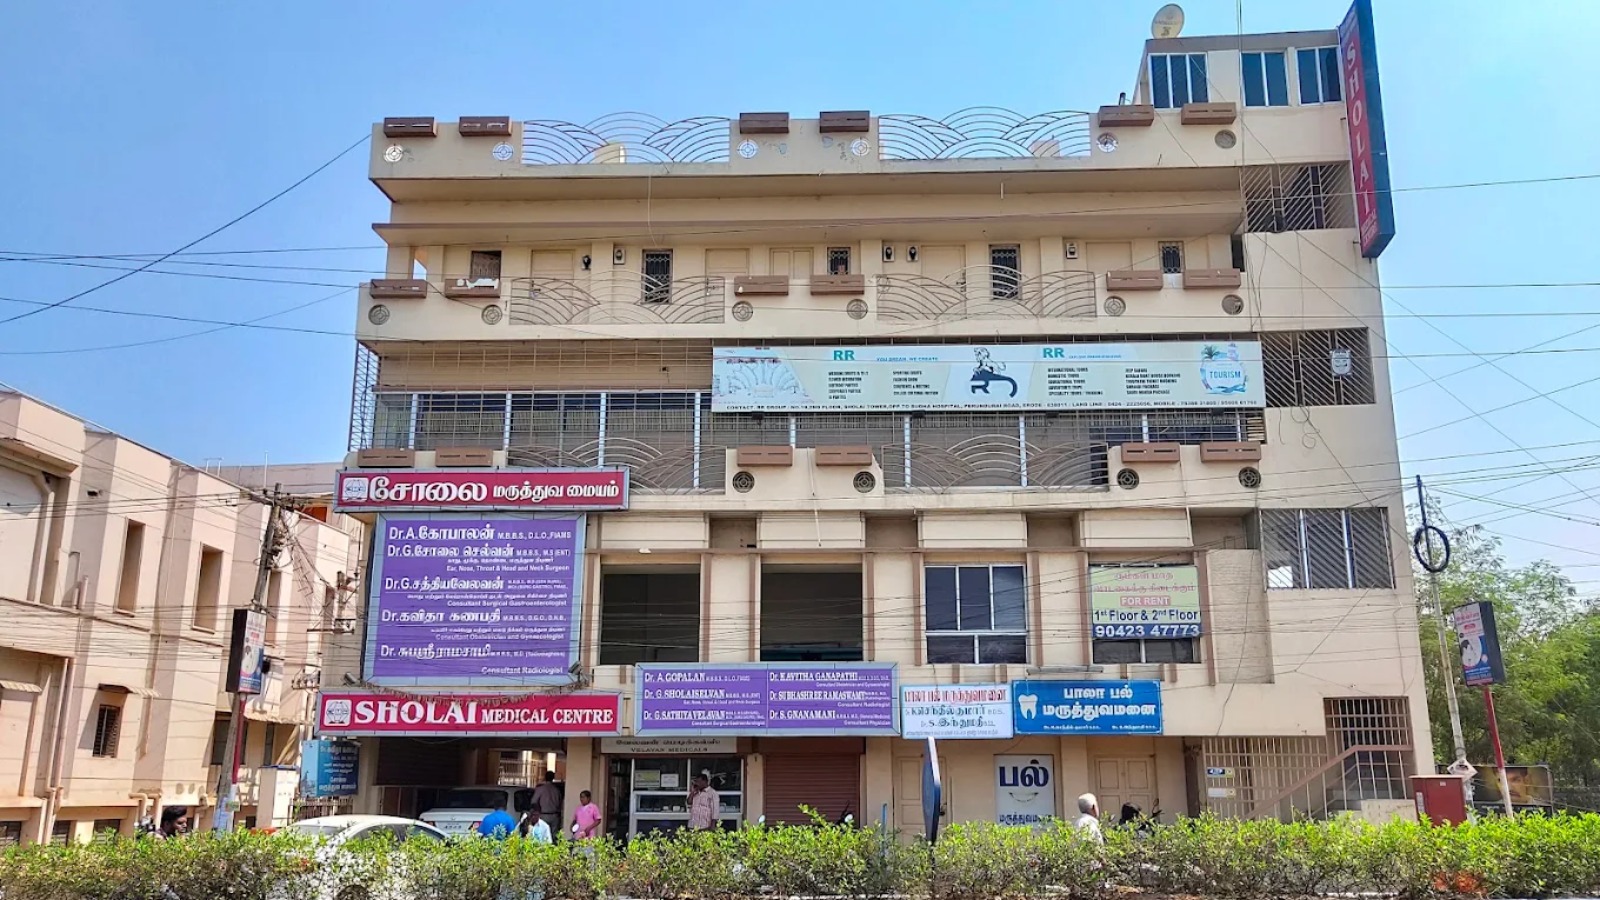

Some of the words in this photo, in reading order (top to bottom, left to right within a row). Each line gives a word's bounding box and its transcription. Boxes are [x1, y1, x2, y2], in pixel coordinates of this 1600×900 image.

[1346, 41, 1370, 216] SHOLAI
[833, 349, 855, 361] RR
[1043, 347, 1065, 359] RR
[1209, 370, 1241, 379] TOURISM
[369, 475, 488, 502] சோலை
[492, 480, 564, 503] மருத்துவ
[566, 479, 619, 498] மையம்
[463, 542, 514, 557] செல்வன்
[545, 564, 570, 572] Surgeon
[1121, 597, 1142, 605] FOR
[1144, 597, 1170, 605] RENT
[449, 608, 501, 624] கணபதி
[1094, 610, 1108, 621] 1st
[1109, 610, 1139, 621] Floor
[1140, 610, 1149, 621] &
[1151, 609, 1167, 621] 2nd
[1169, 609, 1198, 621] Floor
[1095, 625, 1145, 638] 90423
[1150, 625, 1200, 637] 47773
[380, 644, 396, 657] Dr.
[481, 666, 521, 674] Consultant
[522, 666, 563, 674] Radiologist
[779, 672, 815, 681] KAVITHA
[815, 672, 858, 681] GANAPATHI
[1063, 688, 1106, 699] பாலா
[1109, 684, 1134, 699] பல்
[354, 700, 477, 724] SHOLAI
[481, 708, 549, 724] MEDICAL
[552, 708, 614, 724] CENTRE
[1042, 701, 1157, 722] மருத்துவமனை
[999, 759, 1049, 788] பல்
